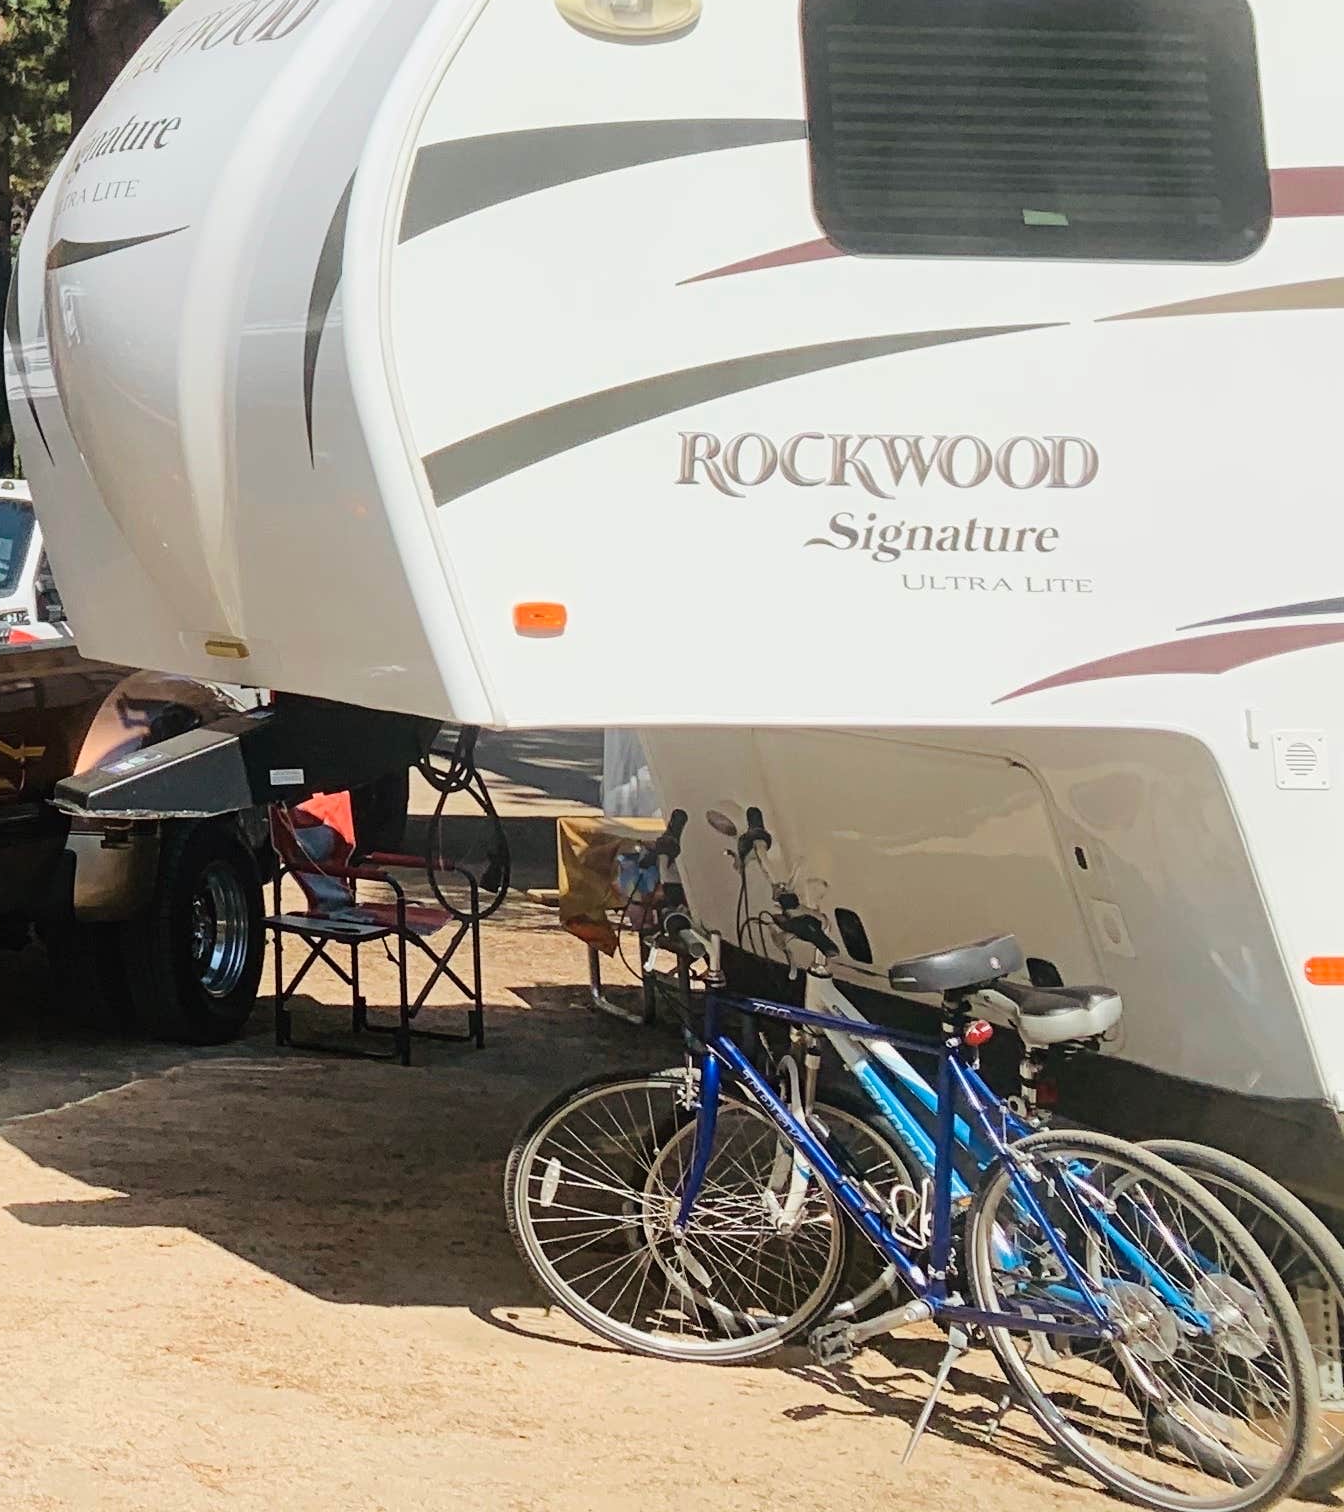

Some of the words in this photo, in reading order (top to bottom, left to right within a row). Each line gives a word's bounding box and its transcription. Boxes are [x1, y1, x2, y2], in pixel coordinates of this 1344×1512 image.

[674, 431, 1100, 500] ROCKWOOD
[802, 511, 1060, 563] Signature
[901, 574, 1014, 592] ULTRA
[1025, 576, 1094, 594] LITE
